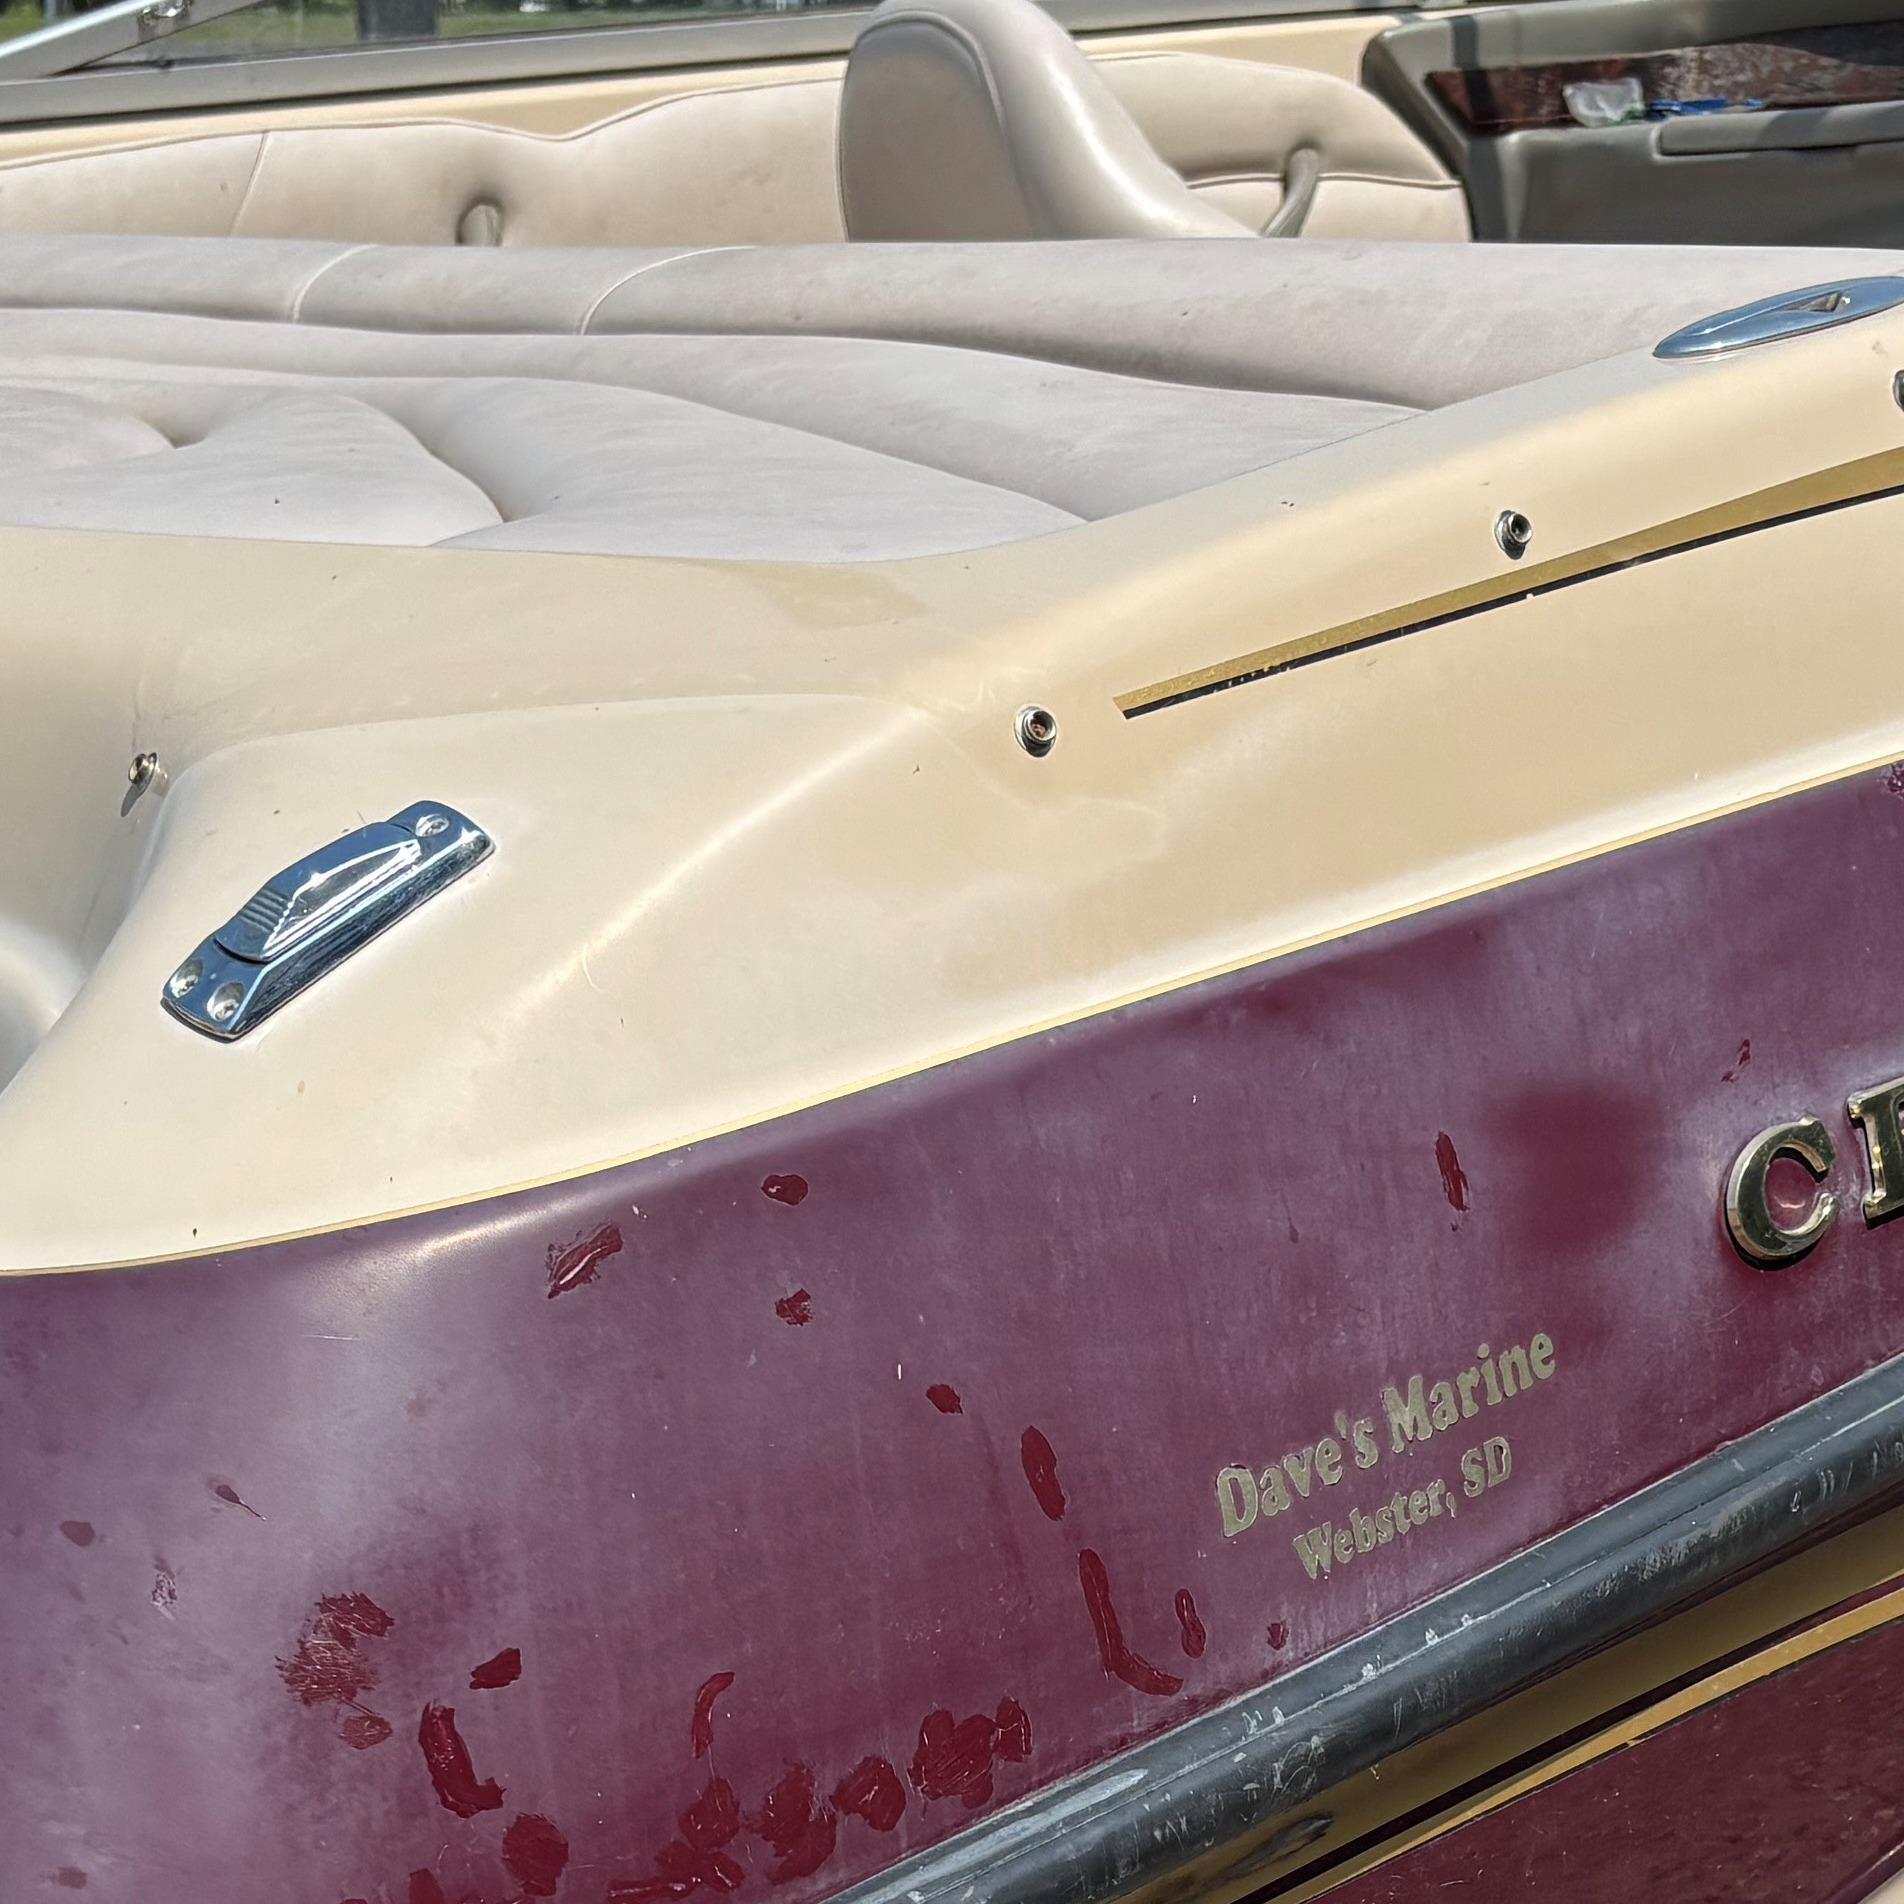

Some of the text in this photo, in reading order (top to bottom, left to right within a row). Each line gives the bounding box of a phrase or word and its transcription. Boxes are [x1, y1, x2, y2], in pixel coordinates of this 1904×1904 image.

[1216, 1332, 1558, 1538] Dave's Marine
[1292, 1435, 1513, 1580] Webster, SD
